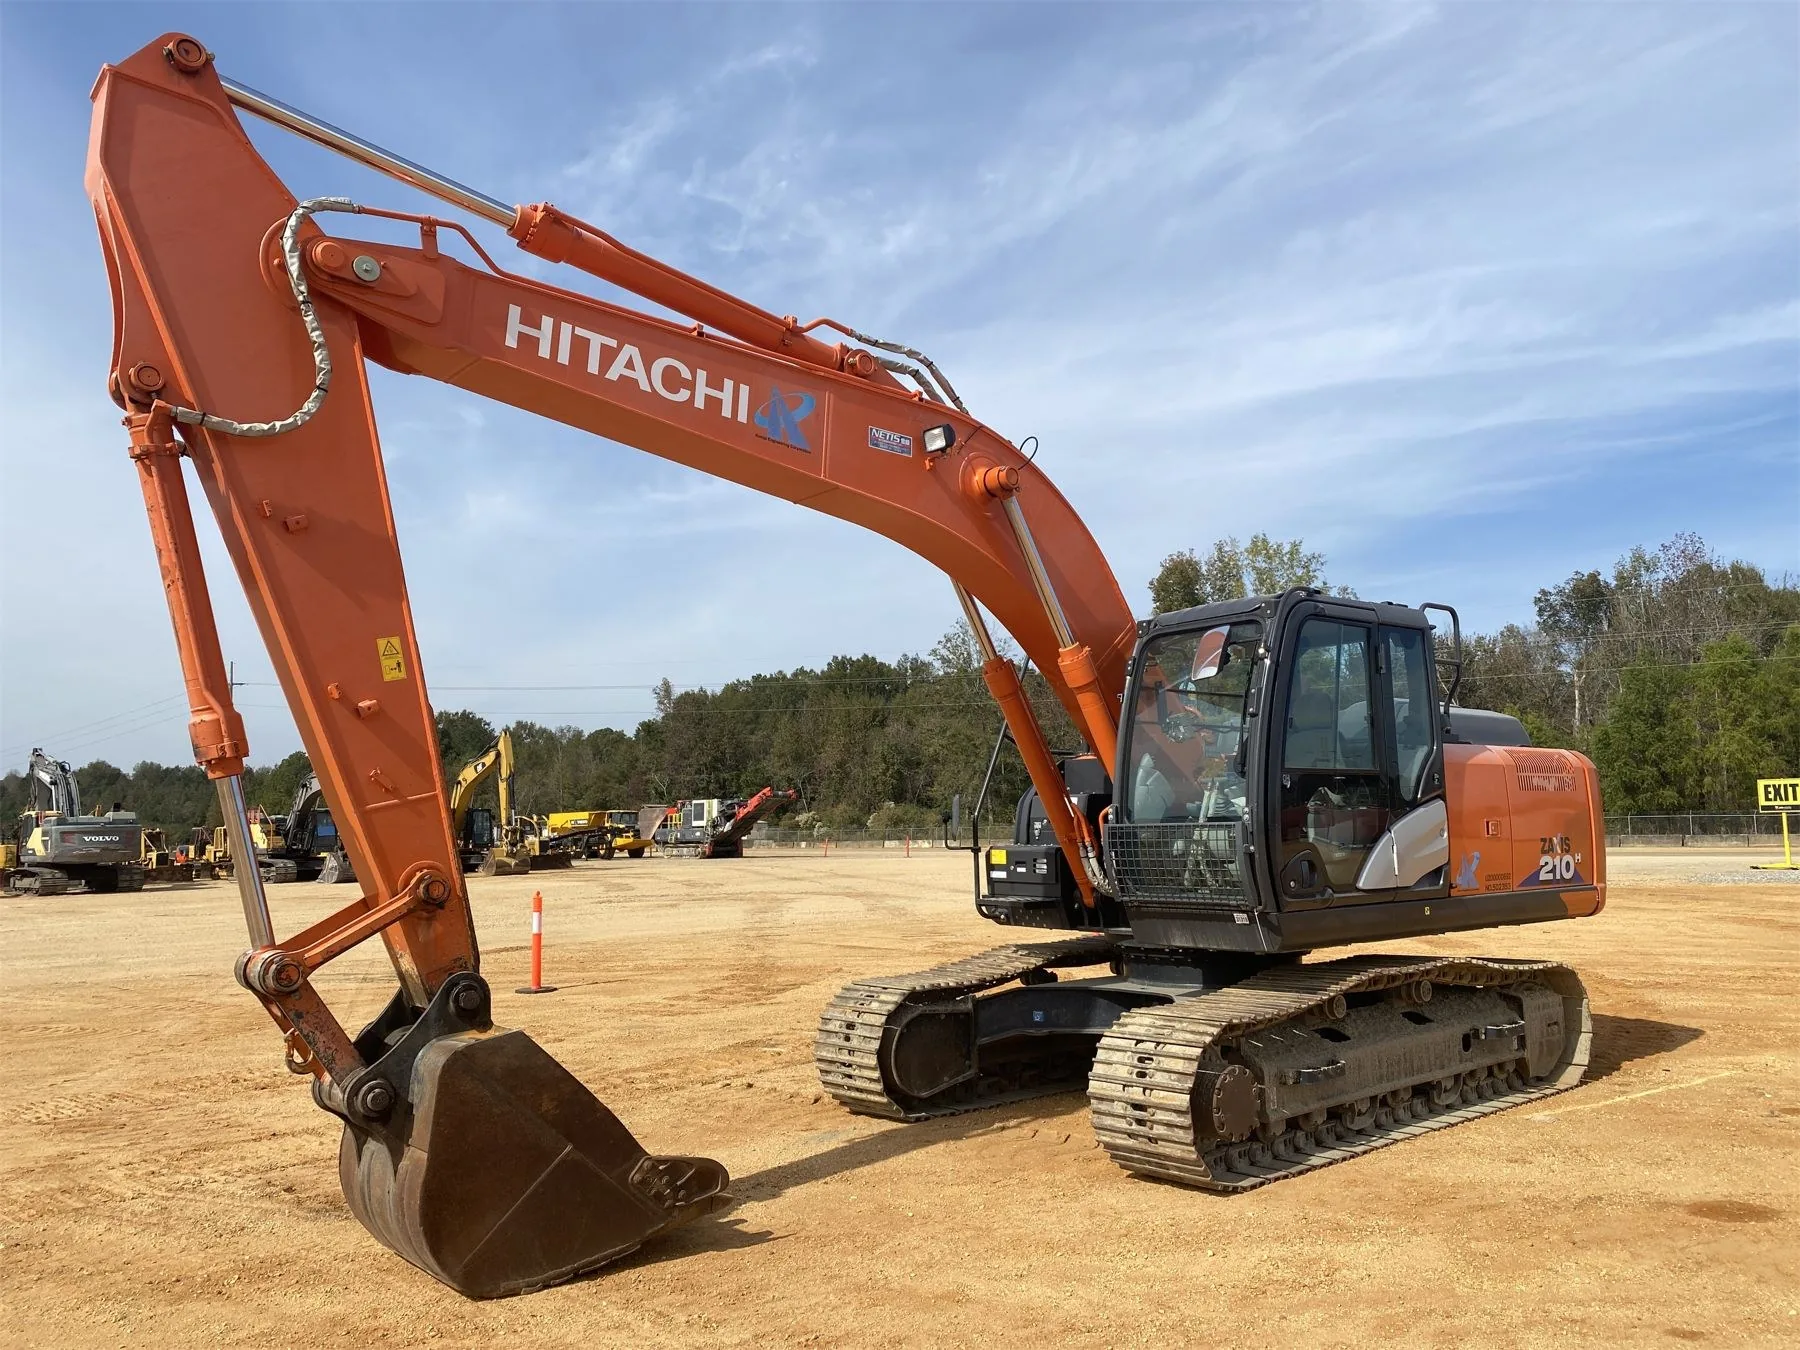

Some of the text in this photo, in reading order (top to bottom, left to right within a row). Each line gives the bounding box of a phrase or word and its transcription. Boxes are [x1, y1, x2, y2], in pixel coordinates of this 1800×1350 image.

[504, 303, 749, 424] HITACHI
[872, 429, 901, 443] NETIS
[1763, 784, 1799, 801] EXIT
[1540, 834, 1571, 854] ZAXIS
[1539, 852, 1581, 880] 210 H
